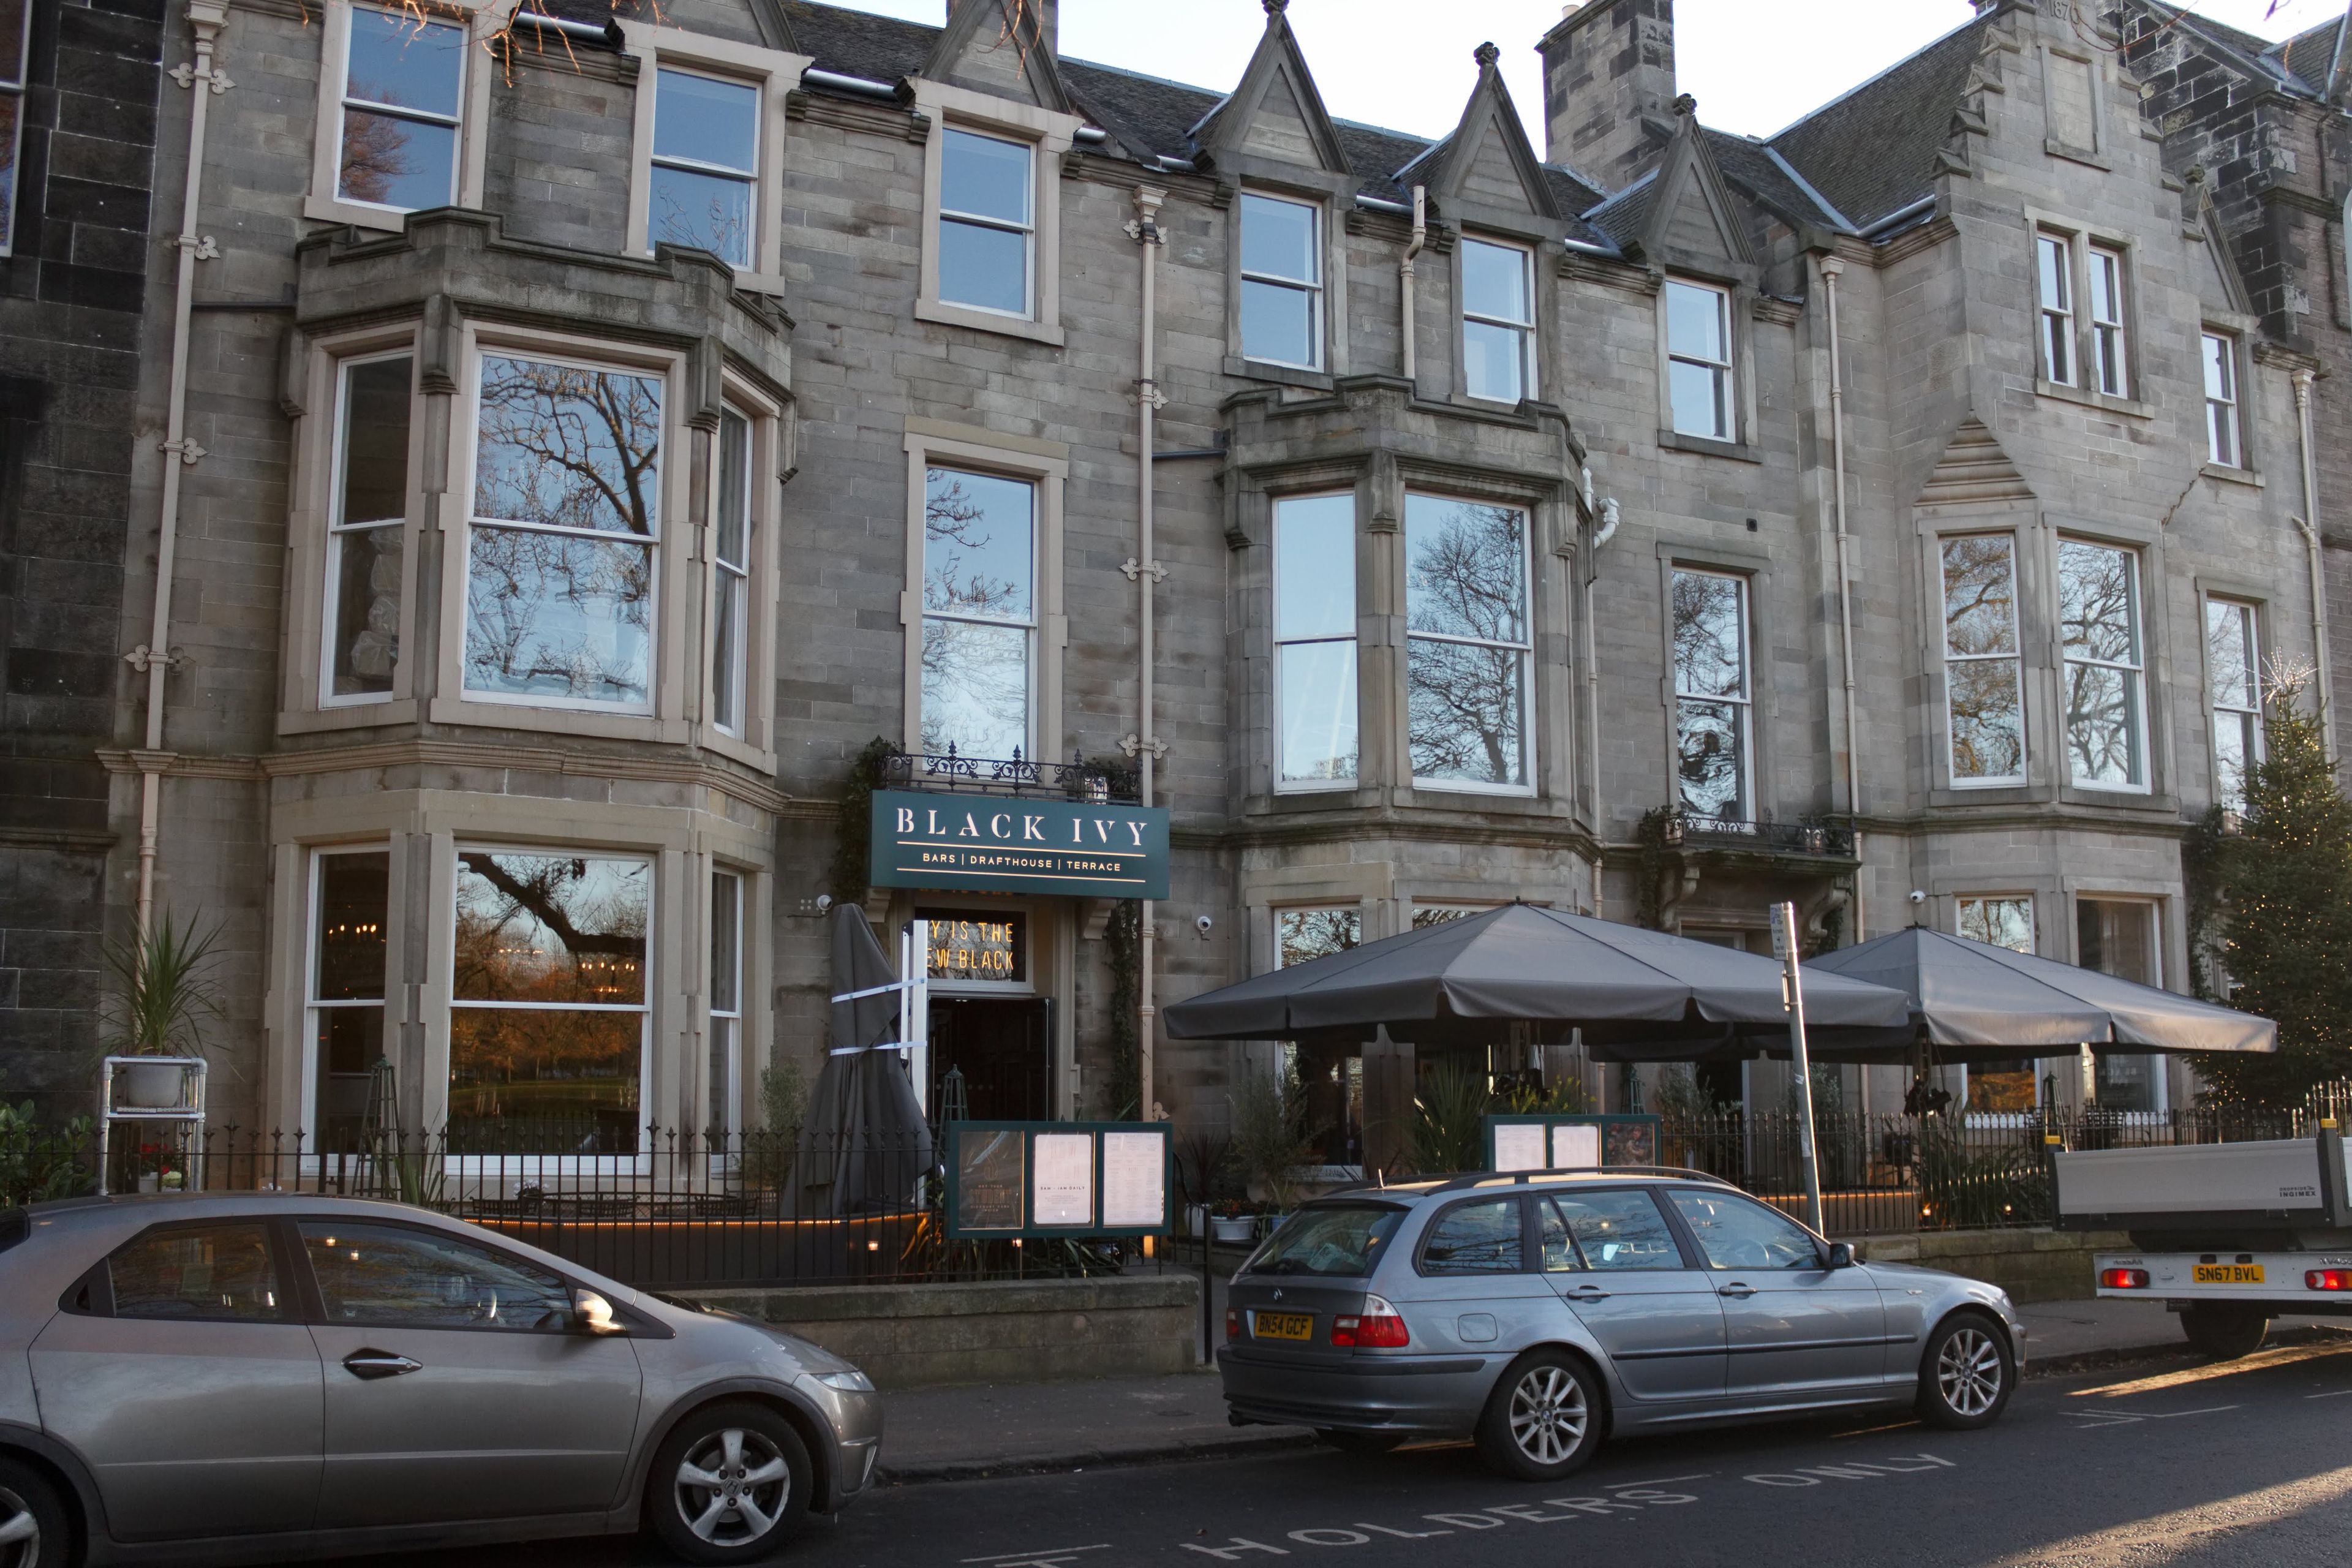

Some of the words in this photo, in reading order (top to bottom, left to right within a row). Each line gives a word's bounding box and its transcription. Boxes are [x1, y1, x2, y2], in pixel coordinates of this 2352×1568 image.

[896, 807, 1046, 841] BLACK
[1072, 818, 1148, 846] IVY
[922, 853, 956, 864] BARS
[970, 856, 1052, 869] DRAFTHOUSE
[1066, 861, 1121, 872] TERRACE
[951, 920, 968, 941] IS
[978, 922, 1014, 943] THE
[959, 949, 1014, 971] BLACK
[2198, 1267, 2230, 1281] SN67
[2234, 1267, 2260, 1281] BVL
[1259, 1314, 1284, 1334] BN54
[1286, 1317, 1308, 1336] GCF
[1179, 1488, 1699, 1560] HOLDERS
[1742, 1453, 1957, 1487] ONLY
